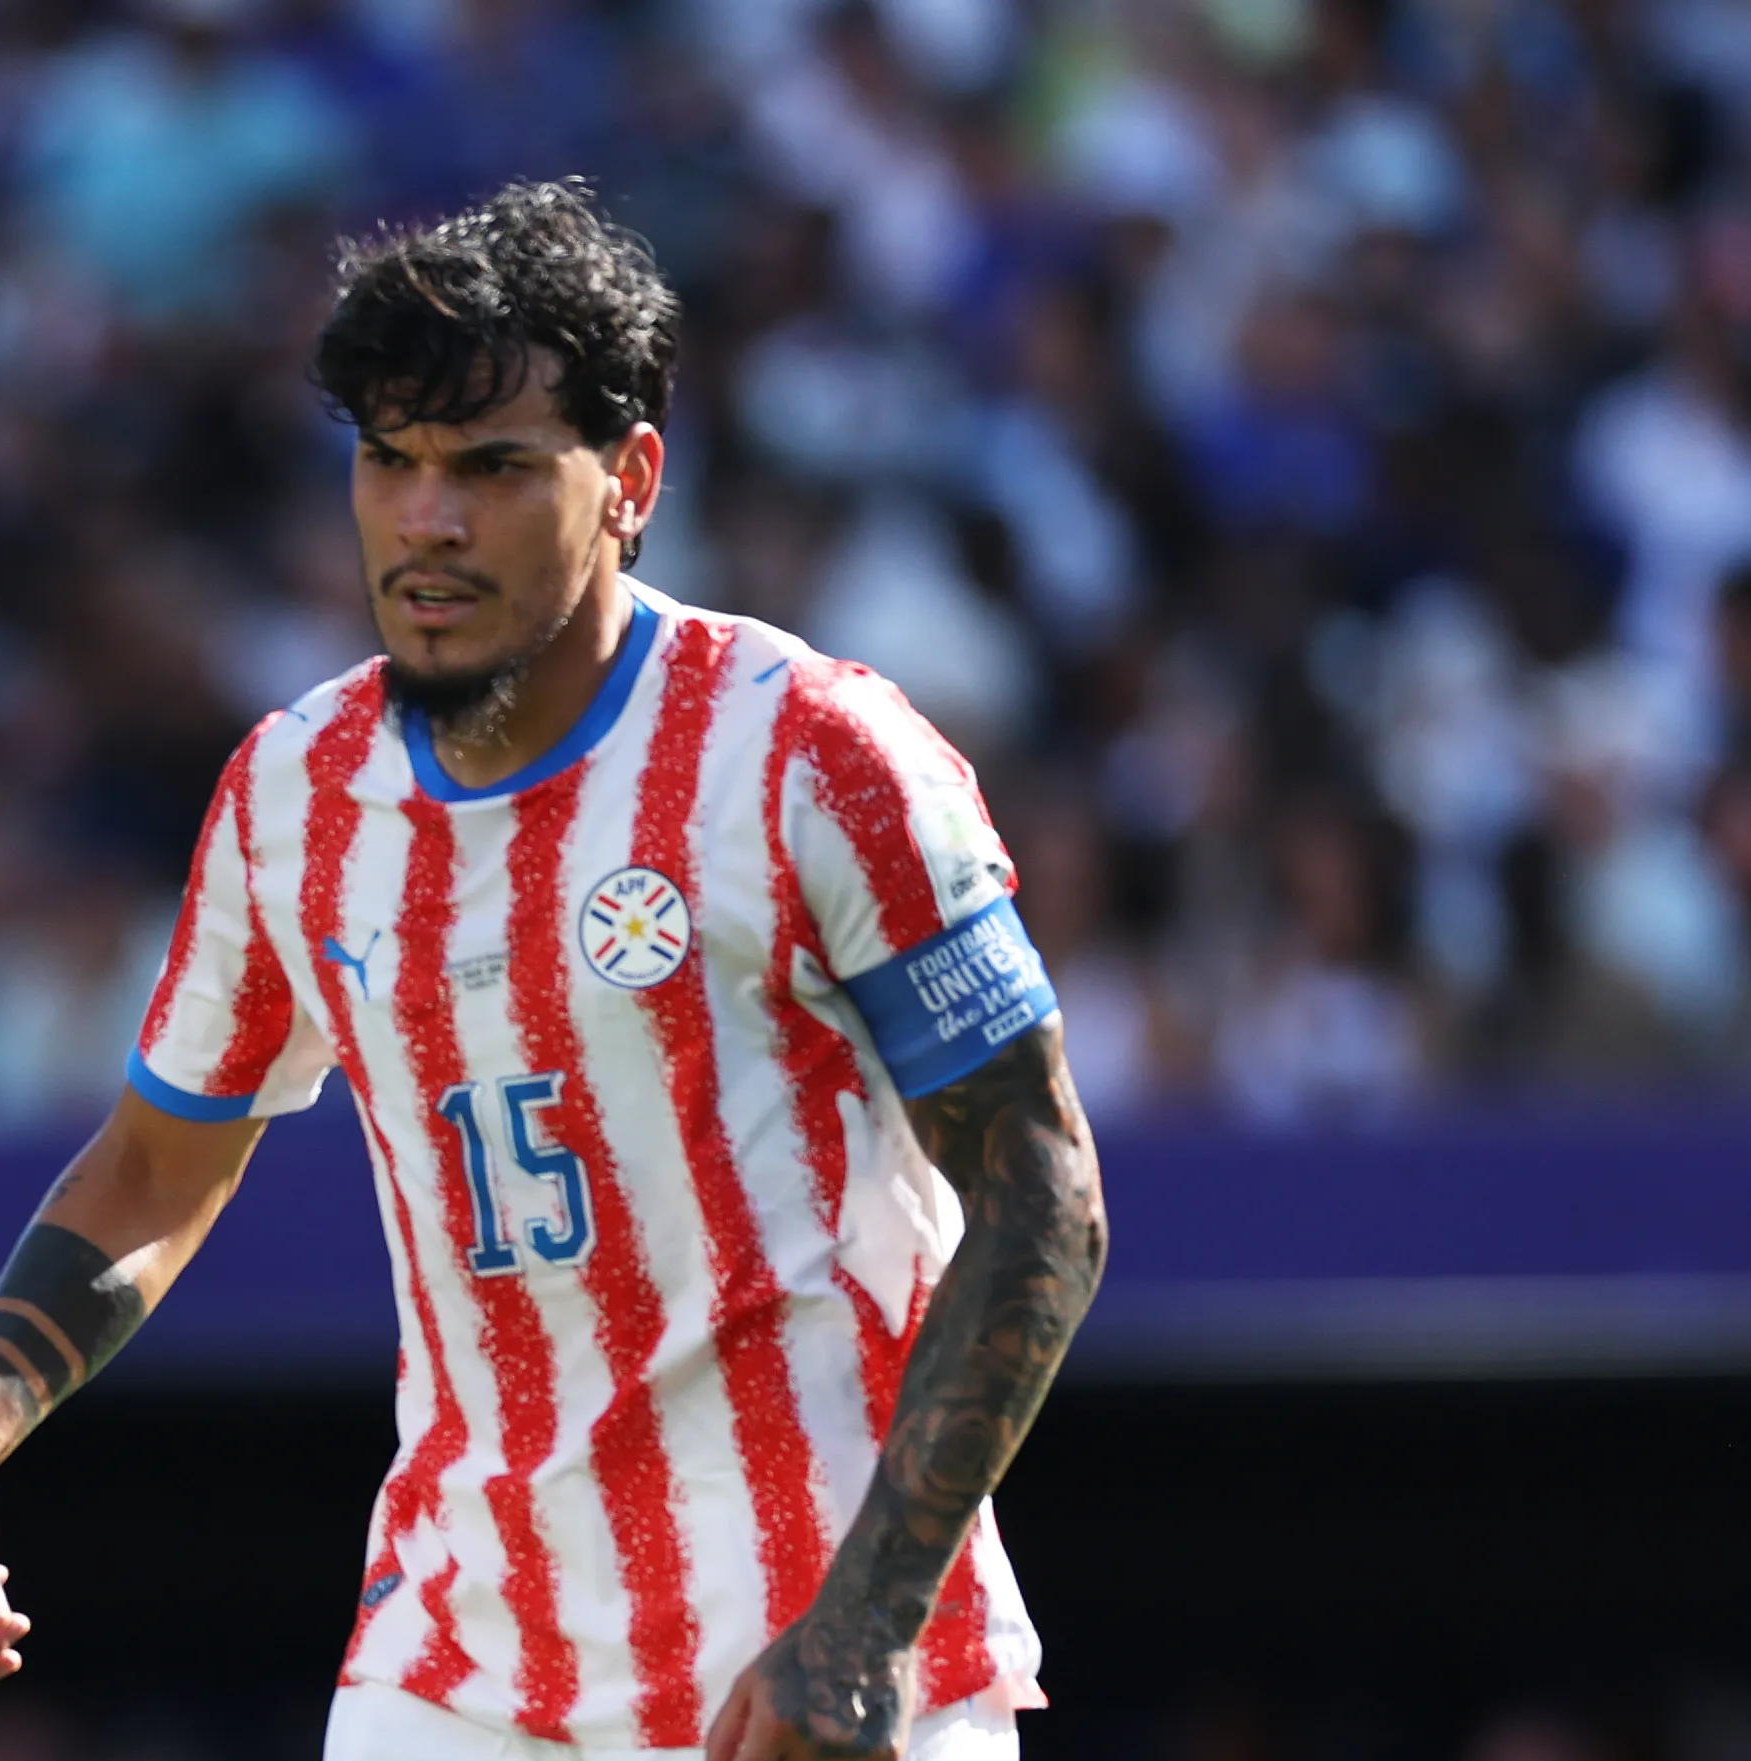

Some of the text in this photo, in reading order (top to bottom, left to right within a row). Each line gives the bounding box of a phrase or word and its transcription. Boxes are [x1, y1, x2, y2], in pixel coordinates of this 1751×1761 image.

[615, 875, 646, 896] APF
[906, 914, 1007, 985] FOOTBALL
[918, 932, 1027, 1013] UNITES
[937, 1008, 983, 1042] the
[436, 1070, 596, 1276] 15
